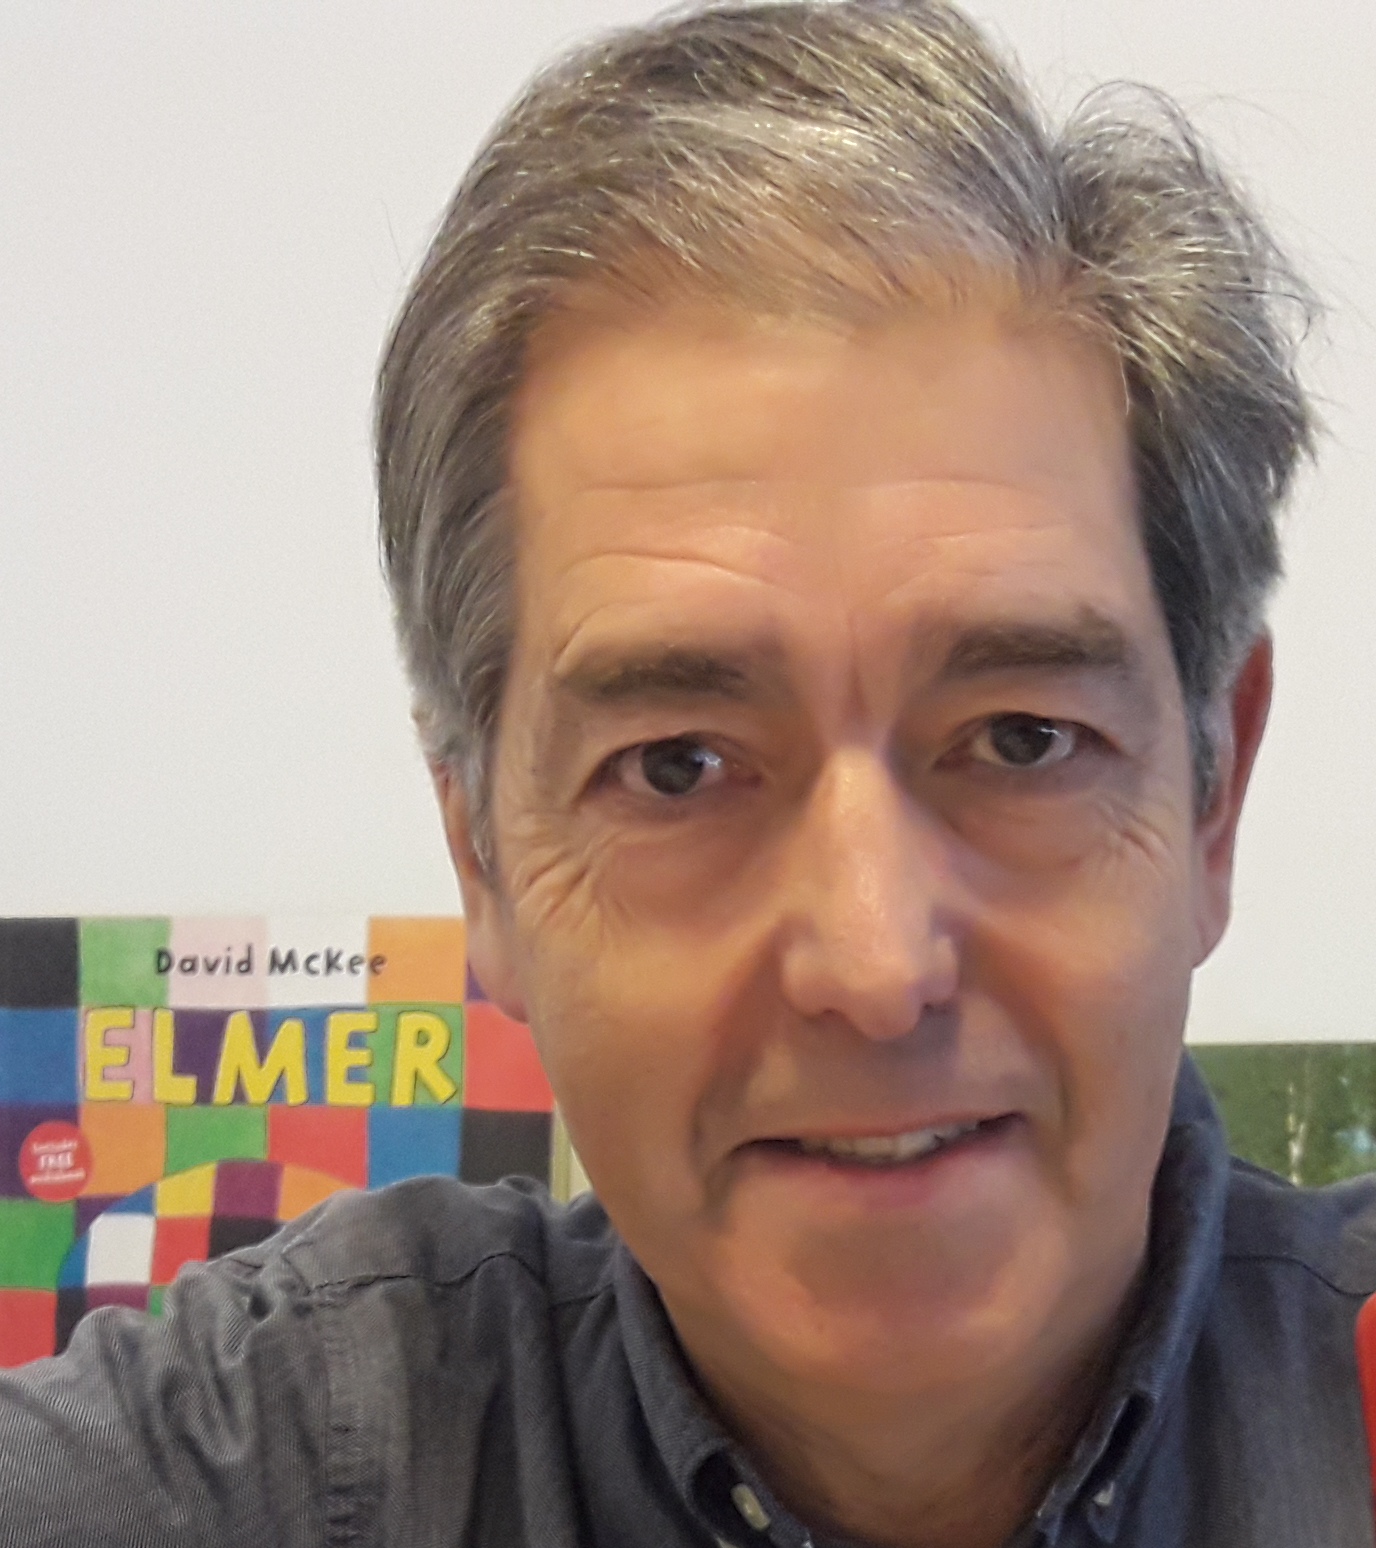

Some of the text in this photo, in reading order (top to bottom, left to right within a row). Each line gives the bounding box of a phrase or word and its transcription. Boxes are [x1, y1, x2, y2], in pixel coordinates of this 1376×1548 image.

[155, 943, 389, 976] David McKee
[82, 1005, 460, 1108] ELMER
